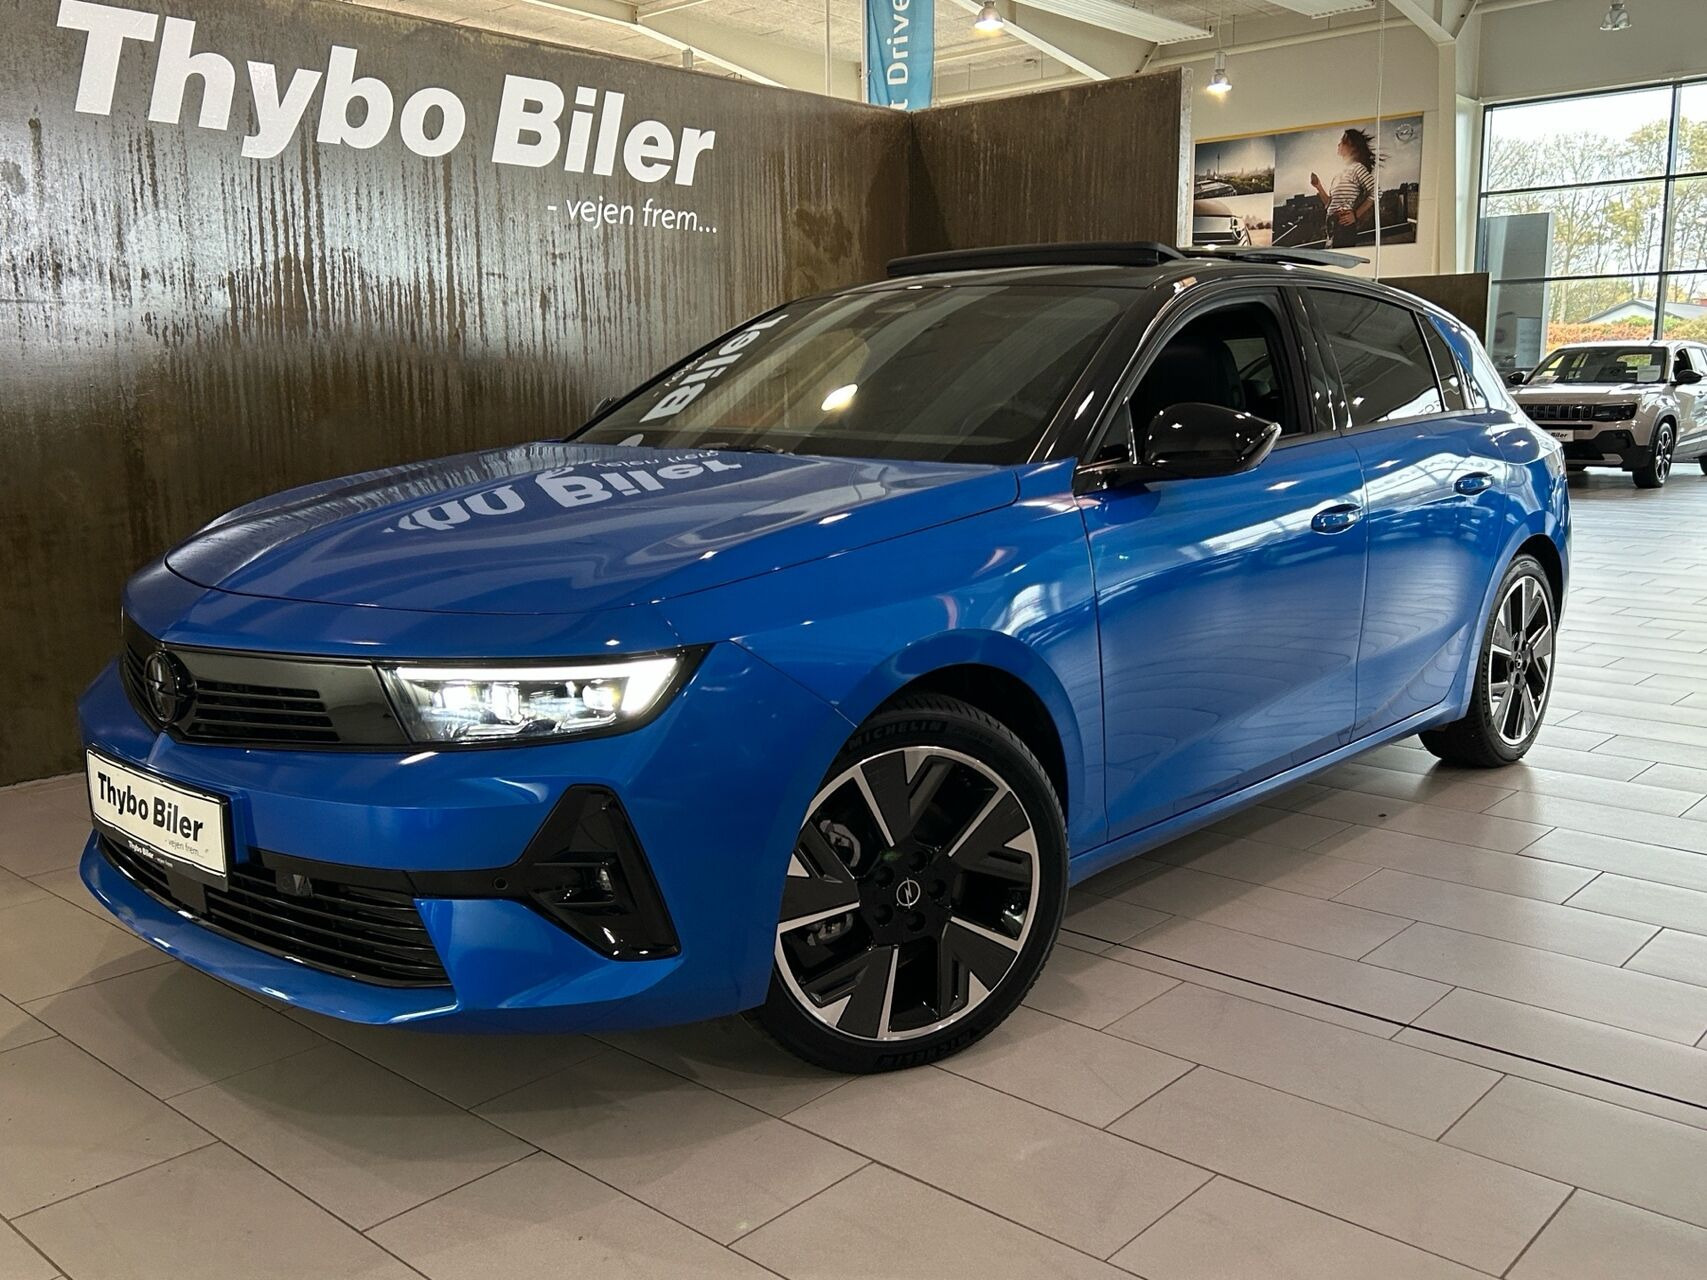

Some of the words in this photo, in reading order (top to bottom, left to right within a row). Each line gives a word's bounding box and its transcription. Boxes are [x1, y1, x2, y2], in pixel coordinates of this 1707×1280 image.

[56, 0, 466, 159] Thybo
[491, 74, 716, 187] Biler
[566, 195, 634, 230] vejen
[642, 198, 717, 234] frem...
[848, 720, 943, 751] MICHELIN
[97, 771, 149, 820] Thybo
[153, 796, 203, 842] Biler
